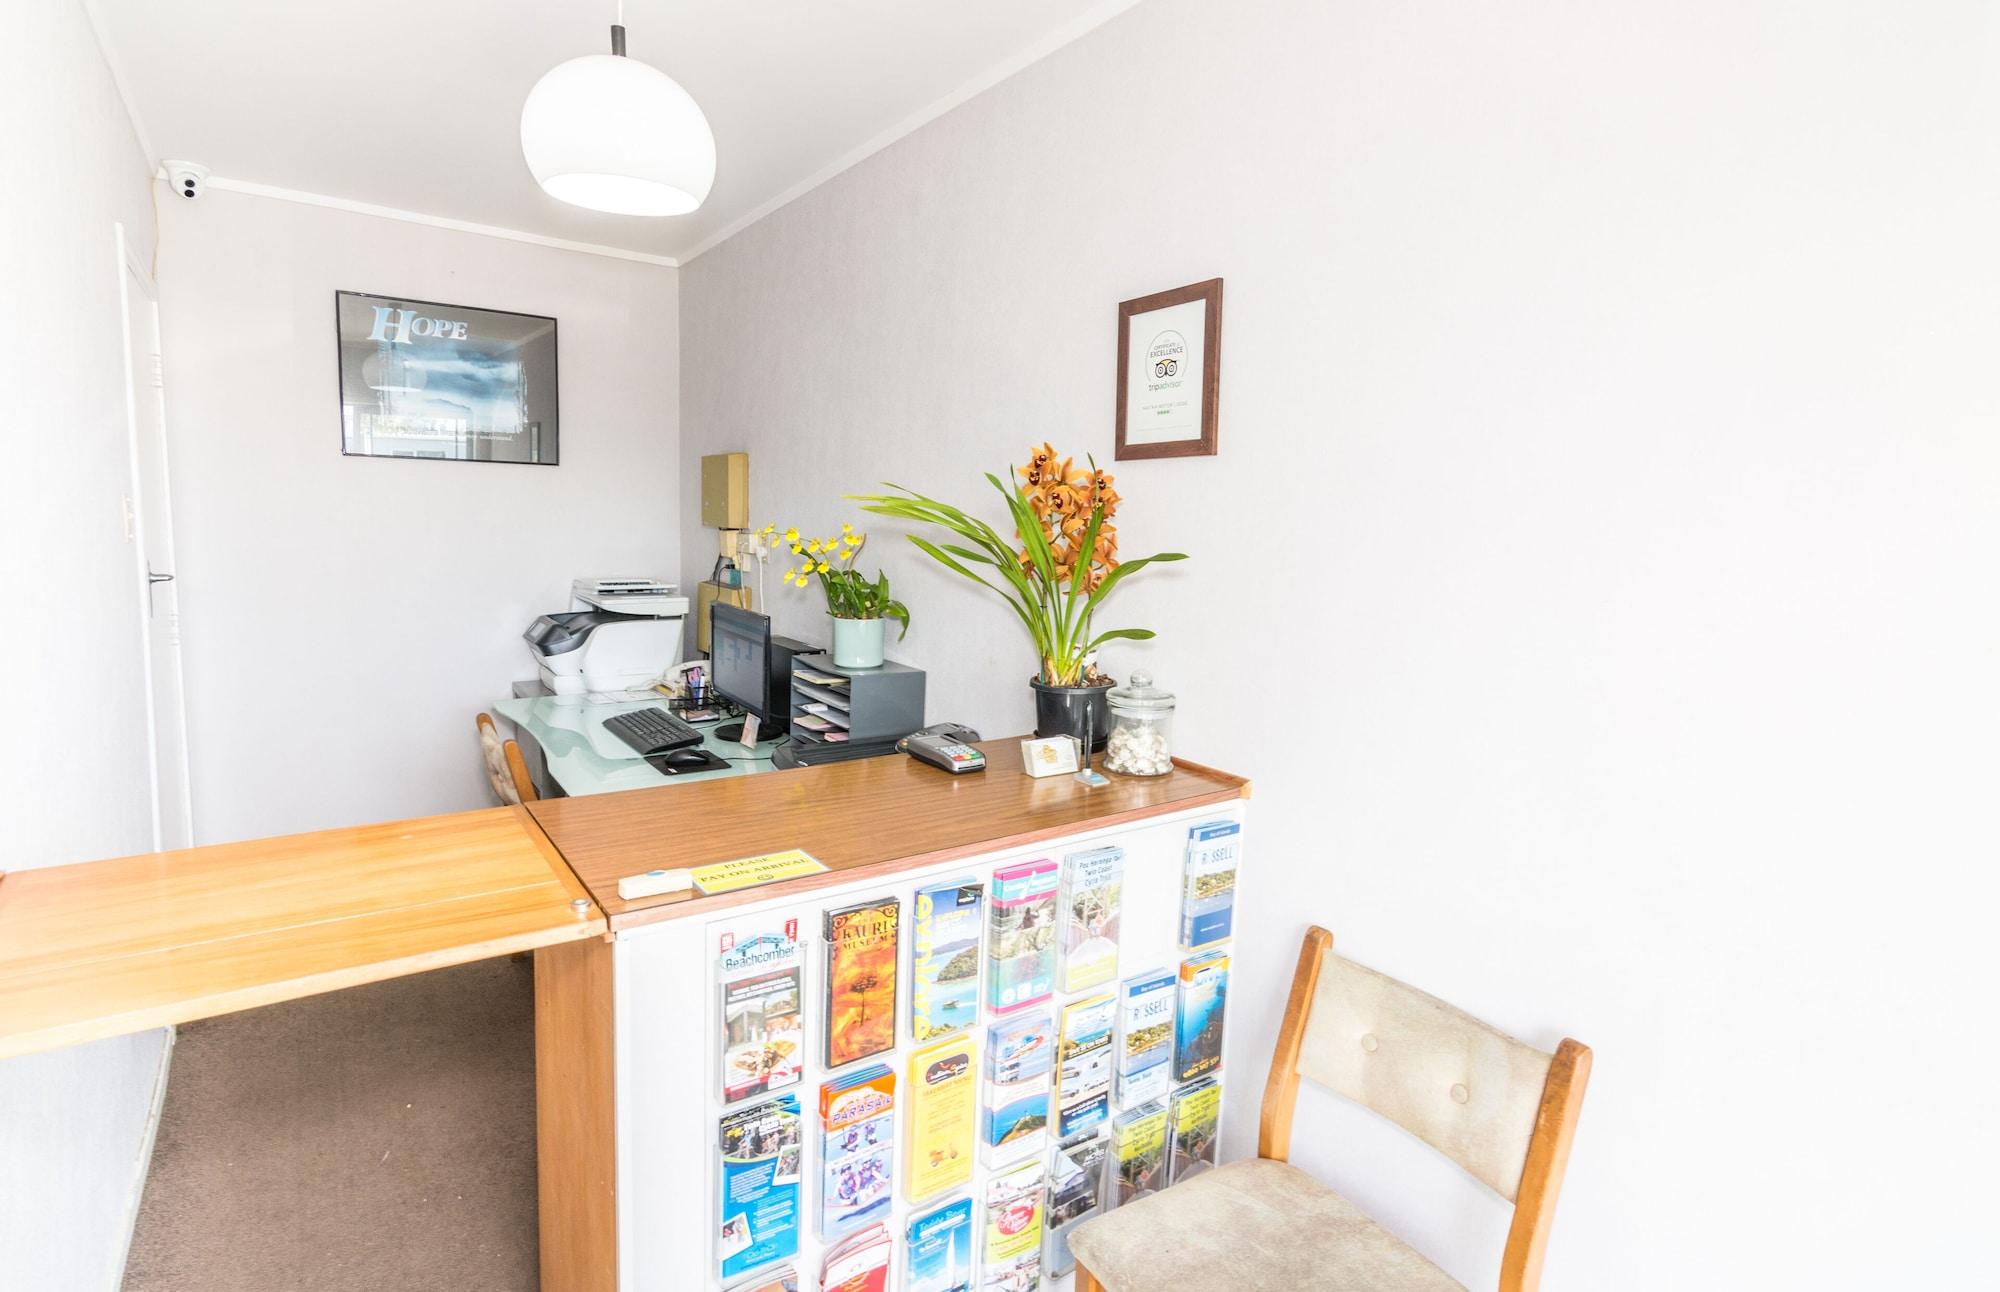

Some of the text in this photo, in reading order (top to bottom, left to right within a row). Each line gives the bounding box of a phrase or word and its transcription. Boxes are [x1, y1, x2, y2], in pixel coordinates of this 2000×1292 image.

[366, 305, 469, 345] HOPE
[1150, 346, 1184, 359] EXCELLENCE
[724, 857, 768, 870] PLEASE
[1202, 847, 1233, 865] RSSELL
[699, 858, 809, 883] PAY ON ARRIVAL
[843, 919, 888, 941] KAURI
[843, 934, 888, 951] MUSEUM
[726, 944, 795, 971] Beachcomber
[1133, 999, 1168, 1020] RSSELL
